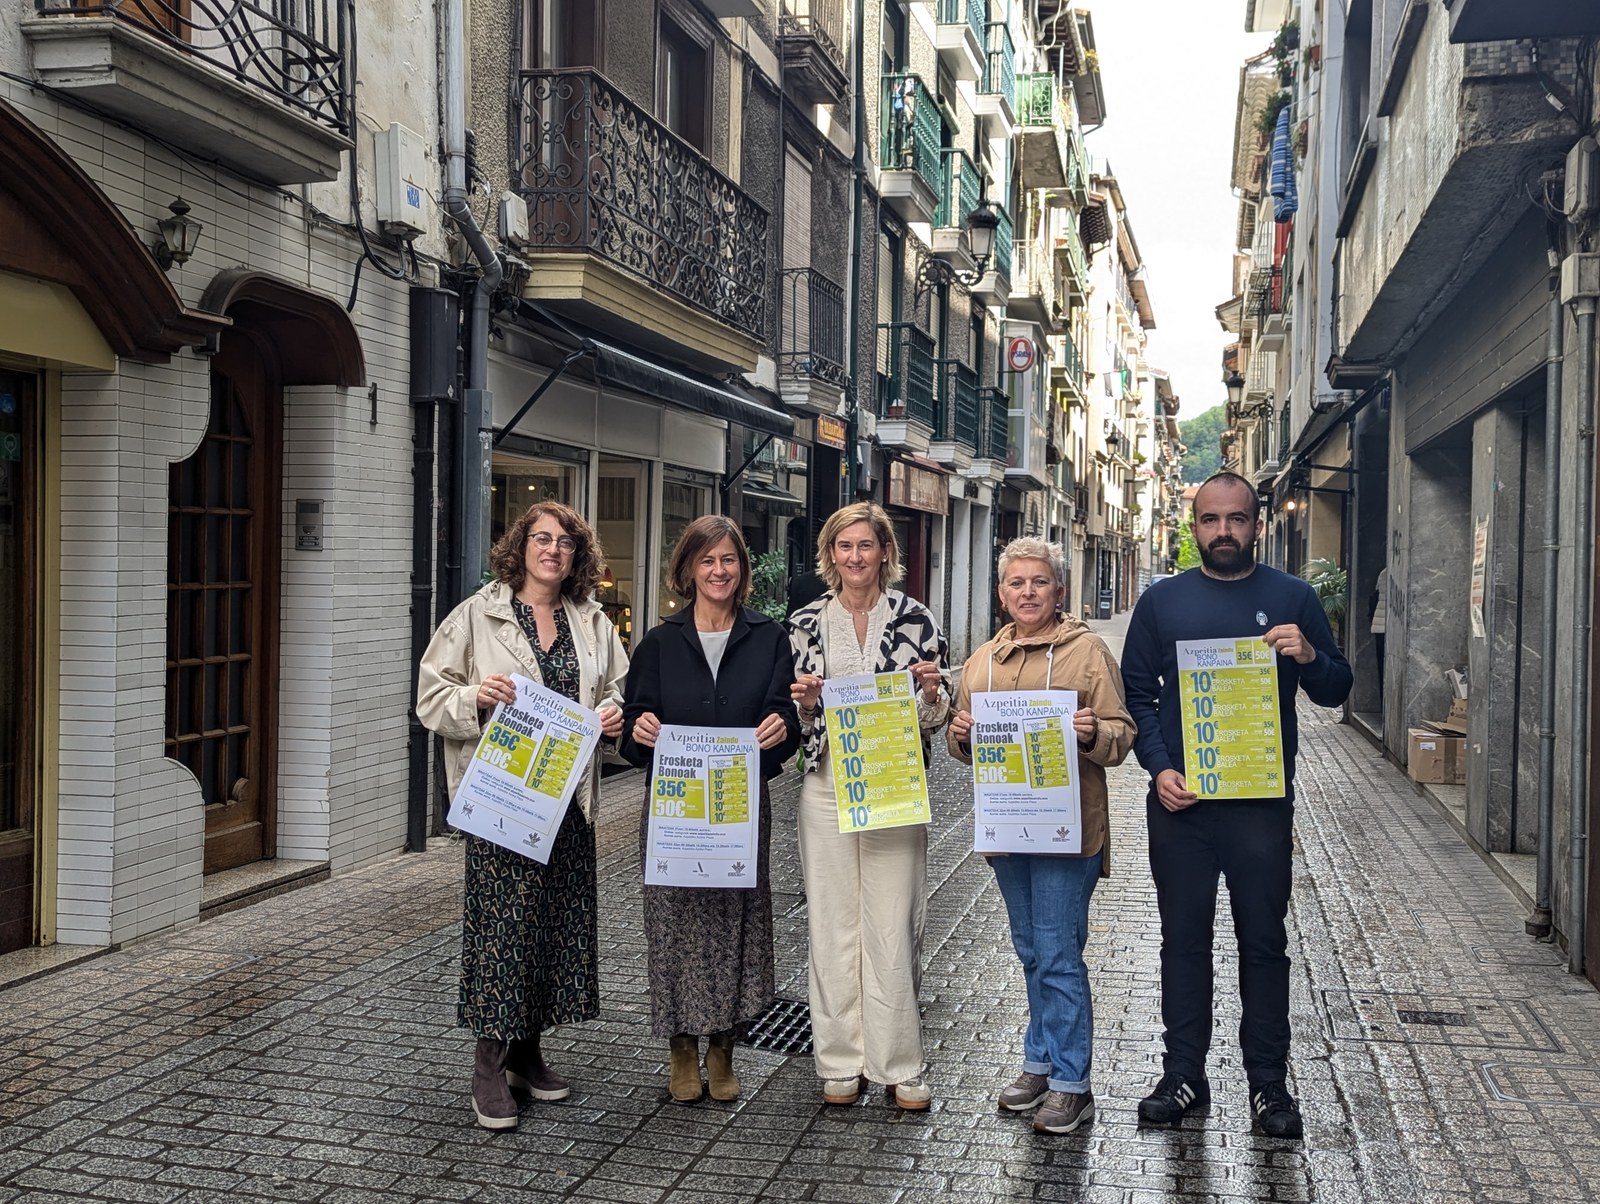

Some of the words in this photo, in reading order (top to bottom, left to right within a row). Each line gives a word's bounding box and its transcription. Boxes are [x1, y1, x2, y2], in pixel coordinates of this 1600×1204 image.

[1183, 646, 1217, 656] Azpeitia
[1237, 652, 1252, 660] 35€
[1255, 651, 1270, 660] 50€
[828, 684, 859, 694] Azpeitia
[840, 690, 860, 698] BONO
[878, 686, 892, 695] 35€
[895, 684, 908, 694] 50€
[1190, 671, 1216, 693] 10€
[519, 684, 564, 712] Azpeitia
[841, 696, 874, 704] KANPAINA
[982, 697, 1027, 711] Azpeitia
[1192, 695, 1216, 718] 10€
[502, 704, 544, 730] Erosketa
[533, 703, 558, 720] BONO
[556, 714, 594, 738] KANPAINA
[836, 706, 859, 729] 10€
[1000, 708, 1024, 717] BONO
[1026, 707, 1070, 716] KANPAINA
[498, 713, 534, 738] Bonoak
[976, 722, 1018, 733] Erosketa
[1194, 721, 1218, 743] 10€
[488, 725, 520, 752] 35€
[667, 731, 714, 745] Azpeitia
[839, 730, 862, 754] 10€
[976, 733, 1014, 744] Bonoak
[480, 744, 512, 770] 50€
[686, 744, 711, 752] BONO
[713, 744, 754, 753] KANPAINA
[977, 746, 1006, 764] 35€
[1195, 746, 1220, 769] 10€
[660, 754, 702, 767] Erosketa
[842, 755, 865, 778] 10€
[658, 766, 696, 778] Bonoak
[978, 766, 1007, 783] 50€
[656, 780, 686, 797] 35€
[845, 779, 868, 803] 10€
[1197, 772, 1222, 795] 10€
[656, 799, 686, 817] 50€
[848, 804, 871, 828] 10€
